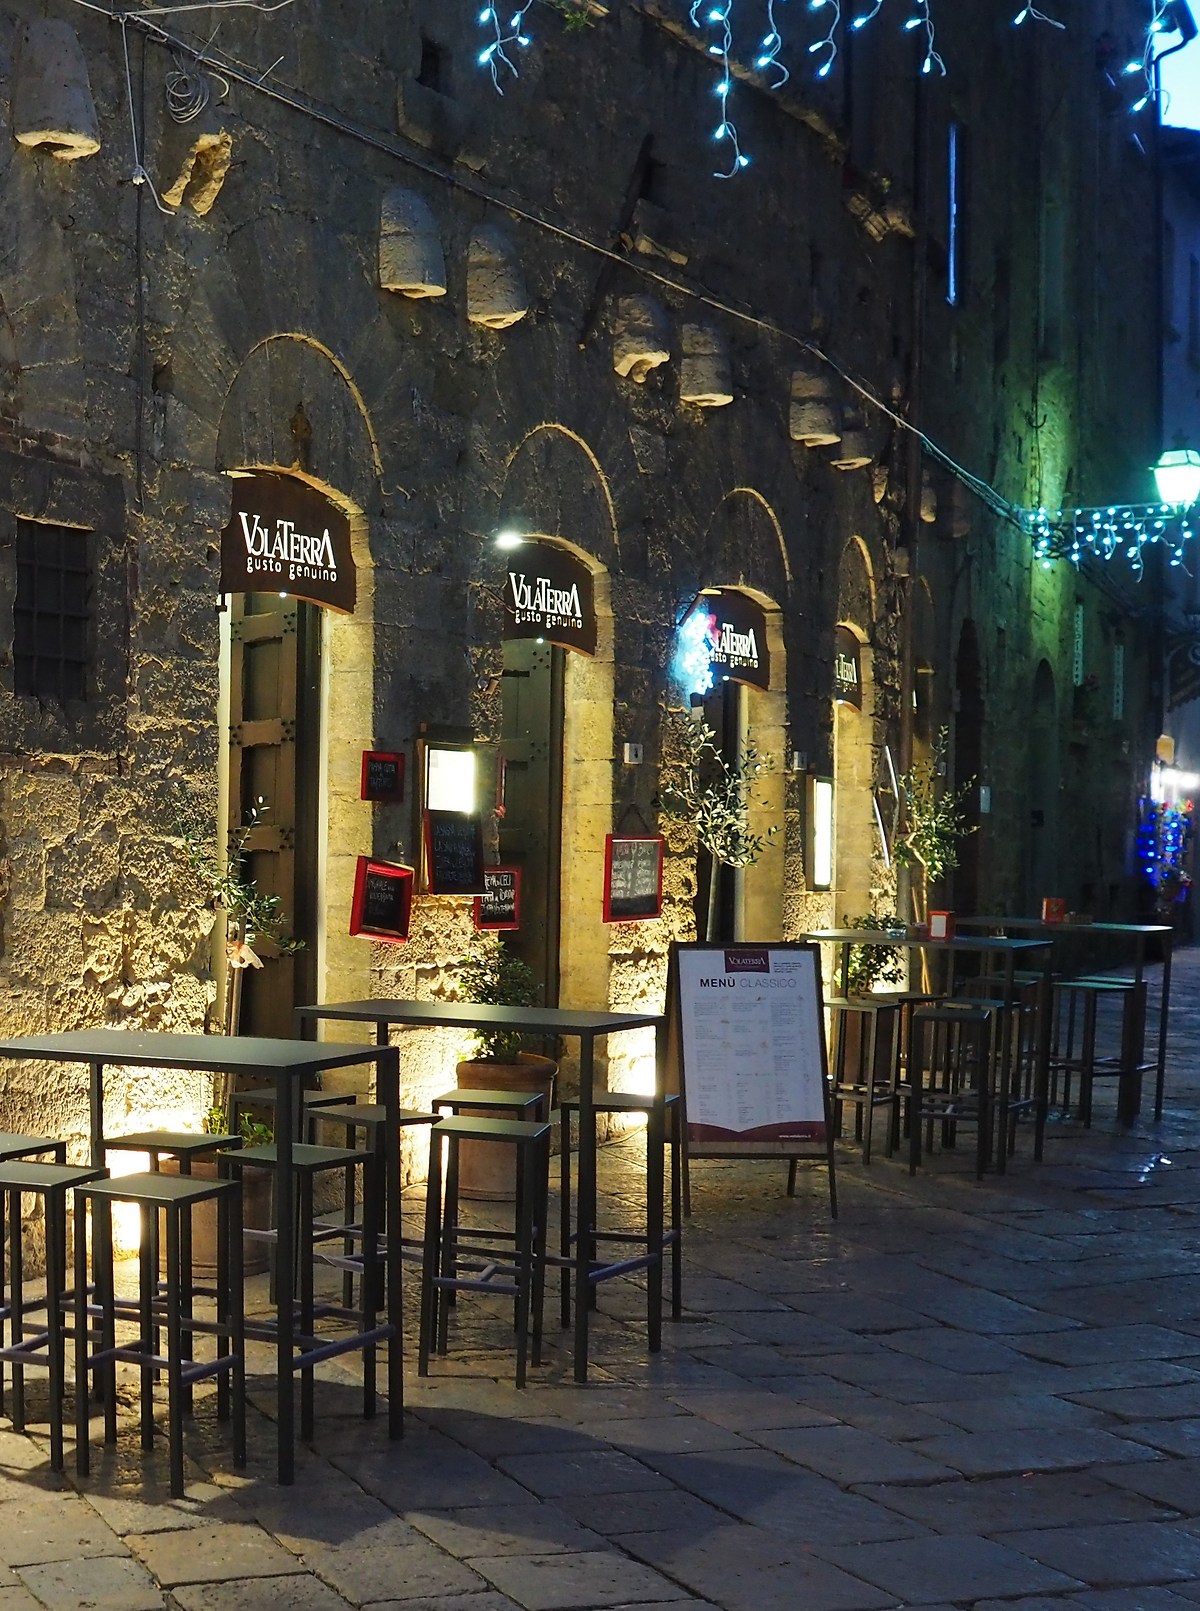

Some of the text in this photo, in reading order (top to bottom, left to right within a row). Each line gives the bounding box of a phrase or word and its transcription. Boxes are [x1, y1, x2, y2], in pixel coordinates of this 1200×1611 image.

[238, 511, 337, 569] VOLATERRA
[246, 556, 337, 582] gusto genuino
[508, 572, 582, 618] VOLATERRA
[515, 609, 583, 629] gusto genuino
[715, 622, 758, 659] LATERRA
[728, 956, 766, 965] VOLATERRA
[699, 976, 797, 989] MENÙ CLASSICO
